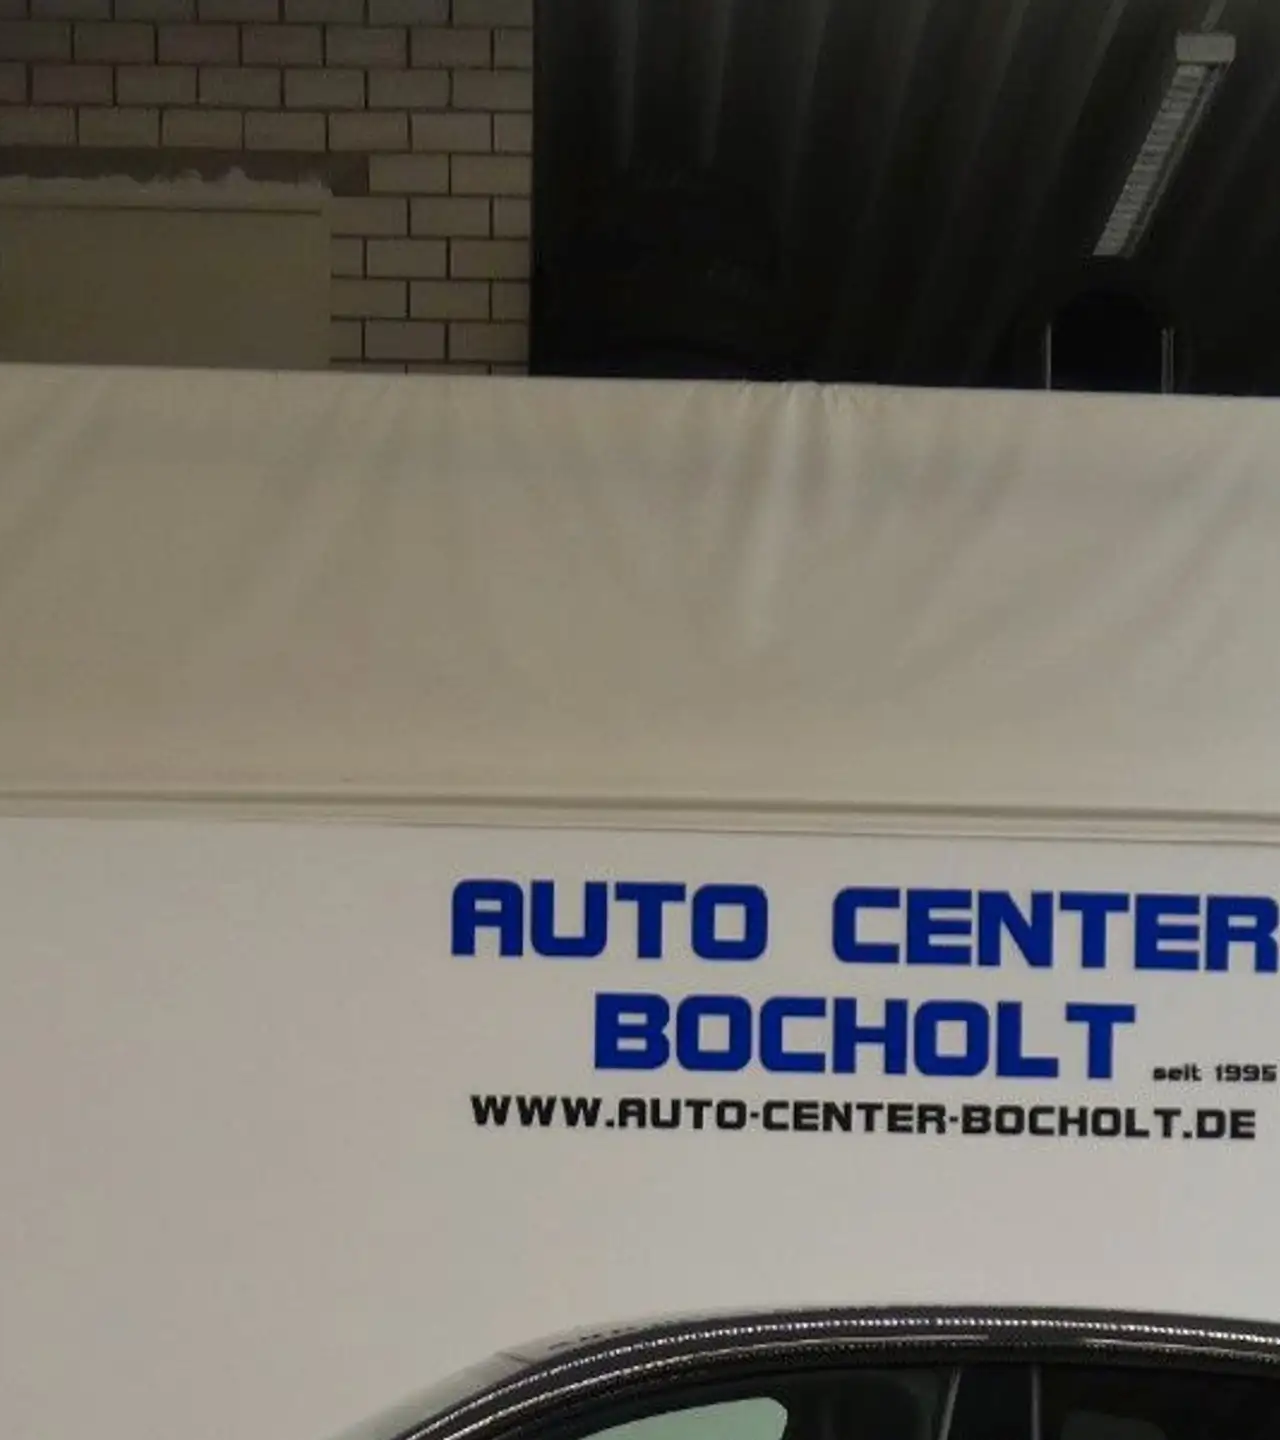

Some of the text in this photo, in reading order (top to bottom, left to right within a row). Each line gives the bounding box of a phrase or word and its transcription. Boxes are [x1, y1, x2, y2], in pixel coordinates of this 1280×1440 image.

[451, 880, 1280, 976] AUTO CENTER
[593, 991, 1277, 1083] BOCHOLT seit 1995
[470, 1094, 1256, 1140] WWW.AUTO-CENTER-BOCHOLT.DE
